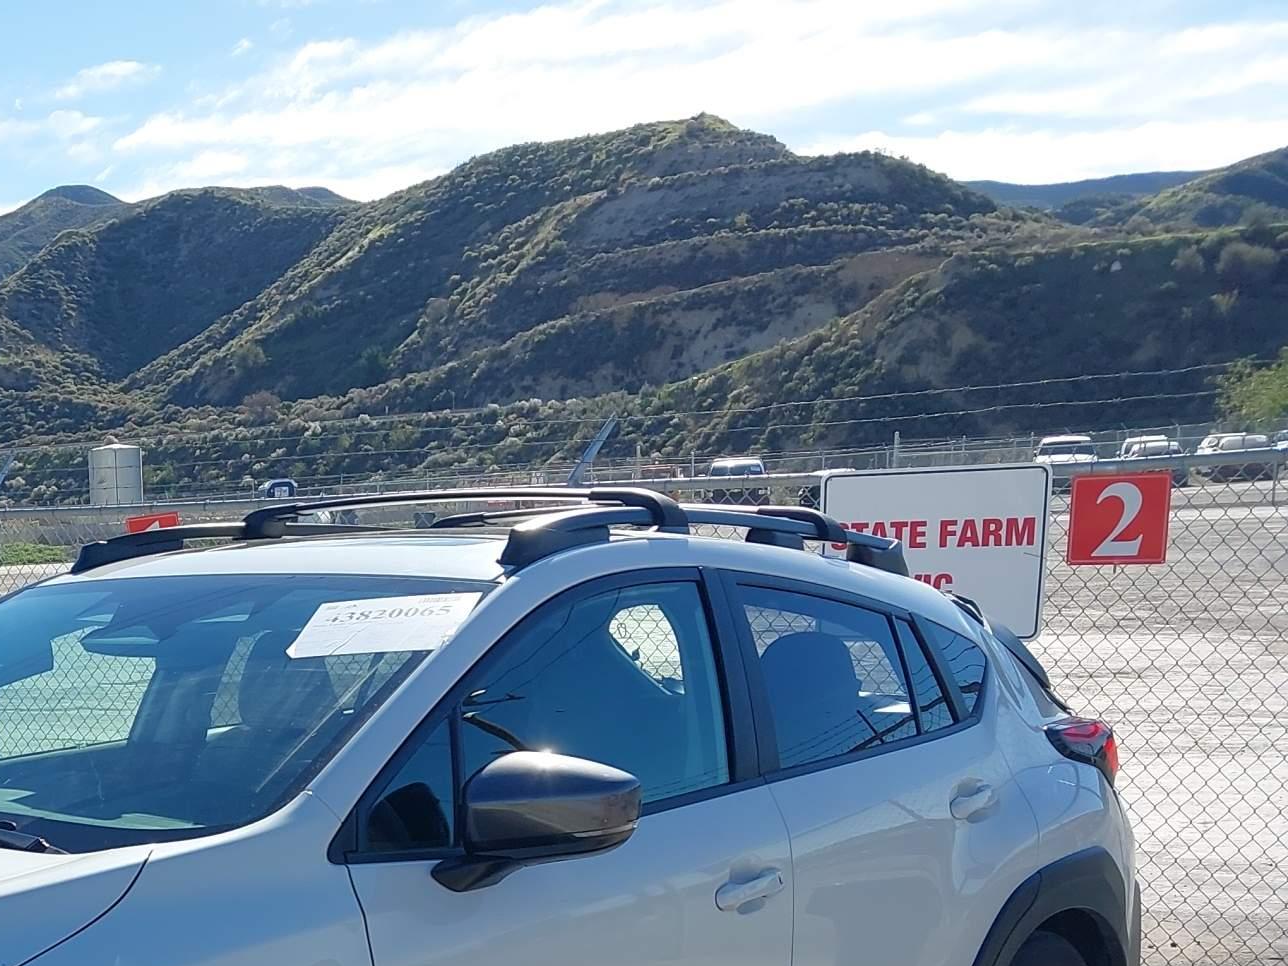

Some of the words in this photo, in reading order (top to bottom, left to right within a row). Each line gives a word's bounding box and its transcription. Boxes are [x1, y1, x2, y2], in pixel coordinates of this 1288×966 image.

[939, 518, 1036, 547] FARM
[1090, 482, 1144, 558] 2
[326, 605, 451, 623] 43820065
